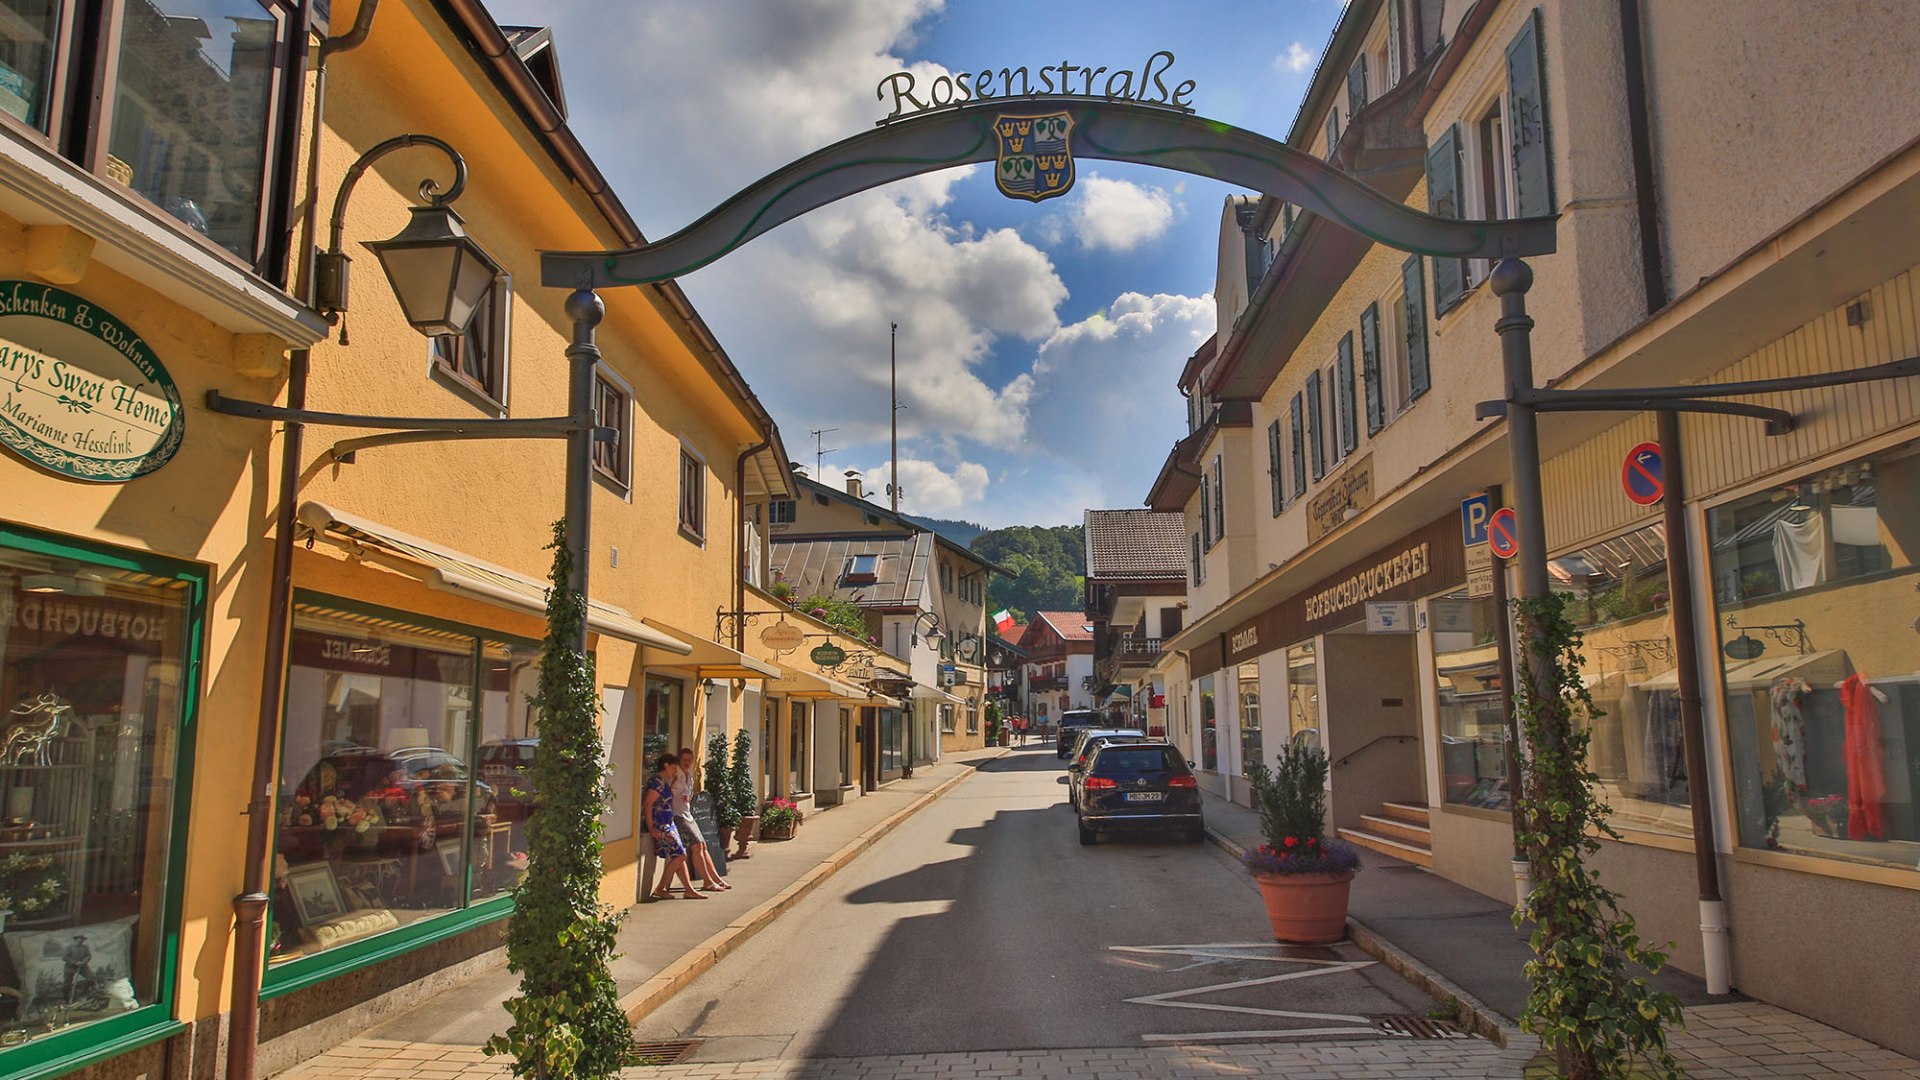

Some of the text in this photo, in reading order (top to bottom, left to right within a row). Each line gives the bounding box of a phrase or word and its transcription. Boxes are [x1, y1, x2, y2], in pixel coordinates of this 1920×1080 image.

[877, 50, 1196, 118] Rosenstraße
[0, 283, 155, 377] Schenken & Wohnen
[2, 393, 132, 454] Marianne Hesselink
[48, 361, 105, 403] Sweet
[111, 384, 168, 427] Home
[1469, 502, 1486, 538] P
[1305, 542, 1430, 621] HOFBUCHDRUCKEREI
[1470, 574, 1494, 583] werktag
